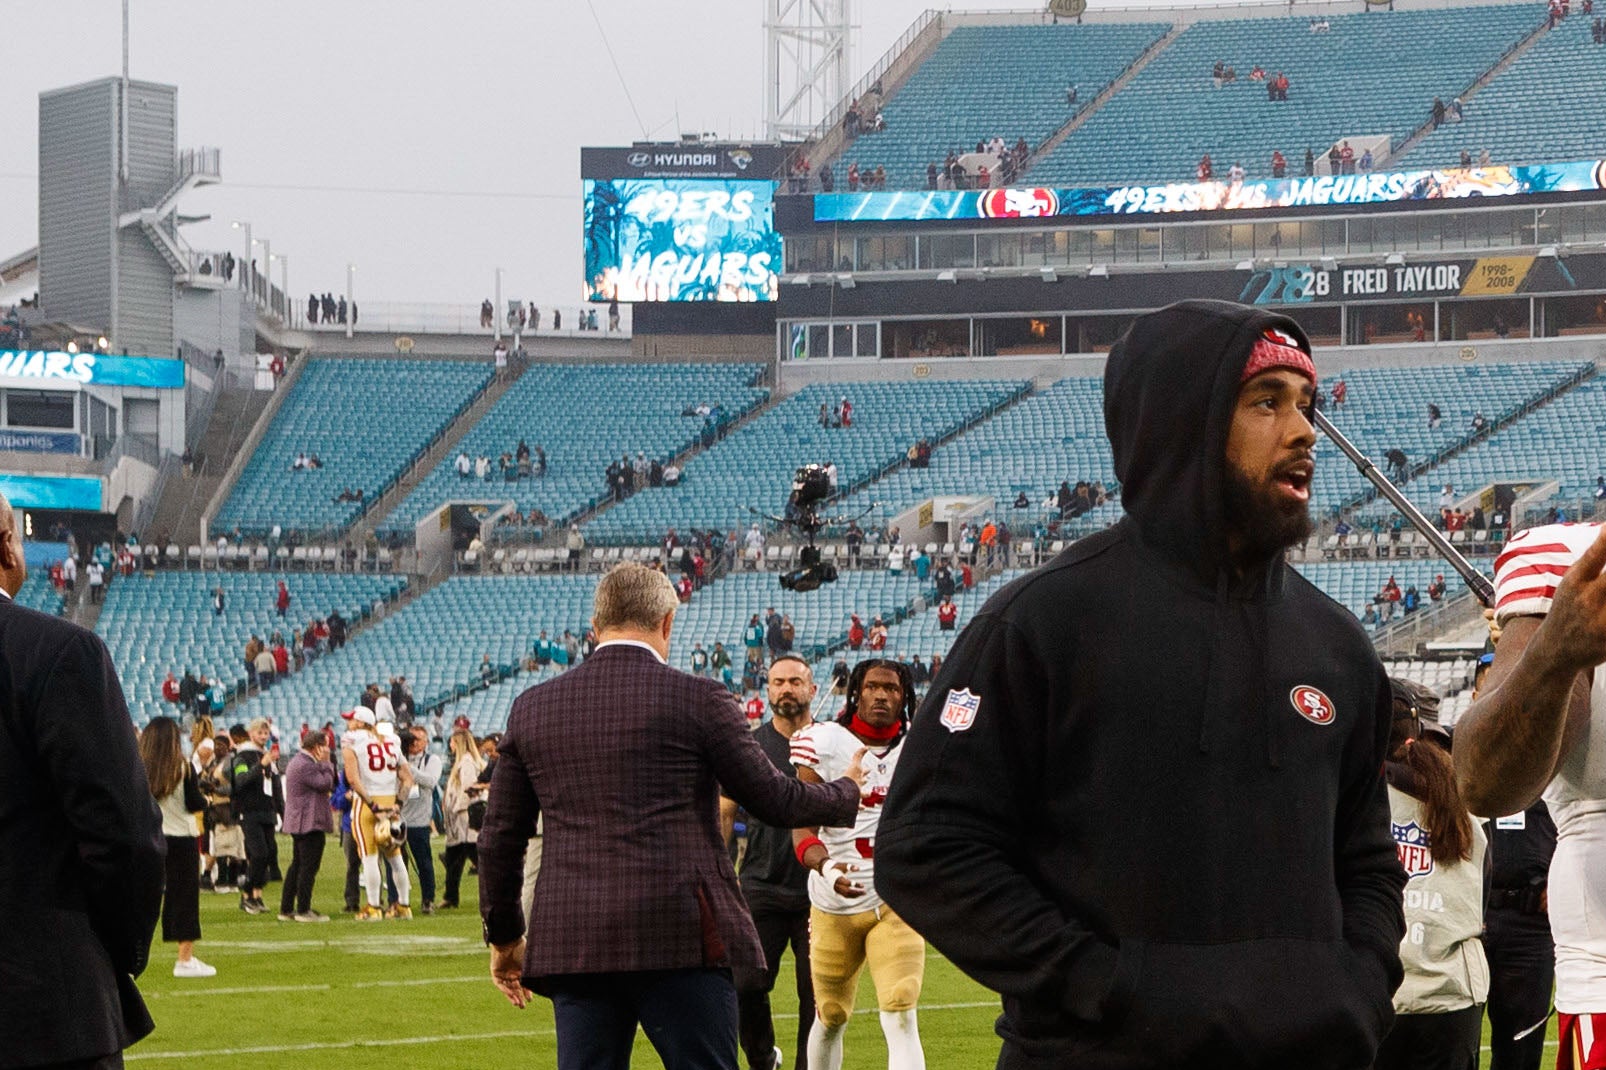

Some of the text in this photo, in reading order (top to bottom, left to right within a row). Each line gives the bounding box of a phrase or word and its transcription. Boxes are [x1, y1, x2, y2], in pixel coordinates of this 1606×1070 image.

[655, 153, 717, 166] HYUNDAI
[1279, 173, 1404, 206] JAGUARS
[625, 189, 755, 224] 49ERS
[673, 224, 708, 248] VS
[612, 251, 772, 291] JAGUARS
[1301, 264, 1461, 296] 28 FRED TAYLOR
[1481, 264, 1514, 277] 1998-
[1486, 276, 1516, 289] 2008
[0, 350, 96, 384] UARS
[367, 743, 398, 772] 85
[1396, 843, 1430, 873] NFL
[1404, 889, 1445, 913] DIA
